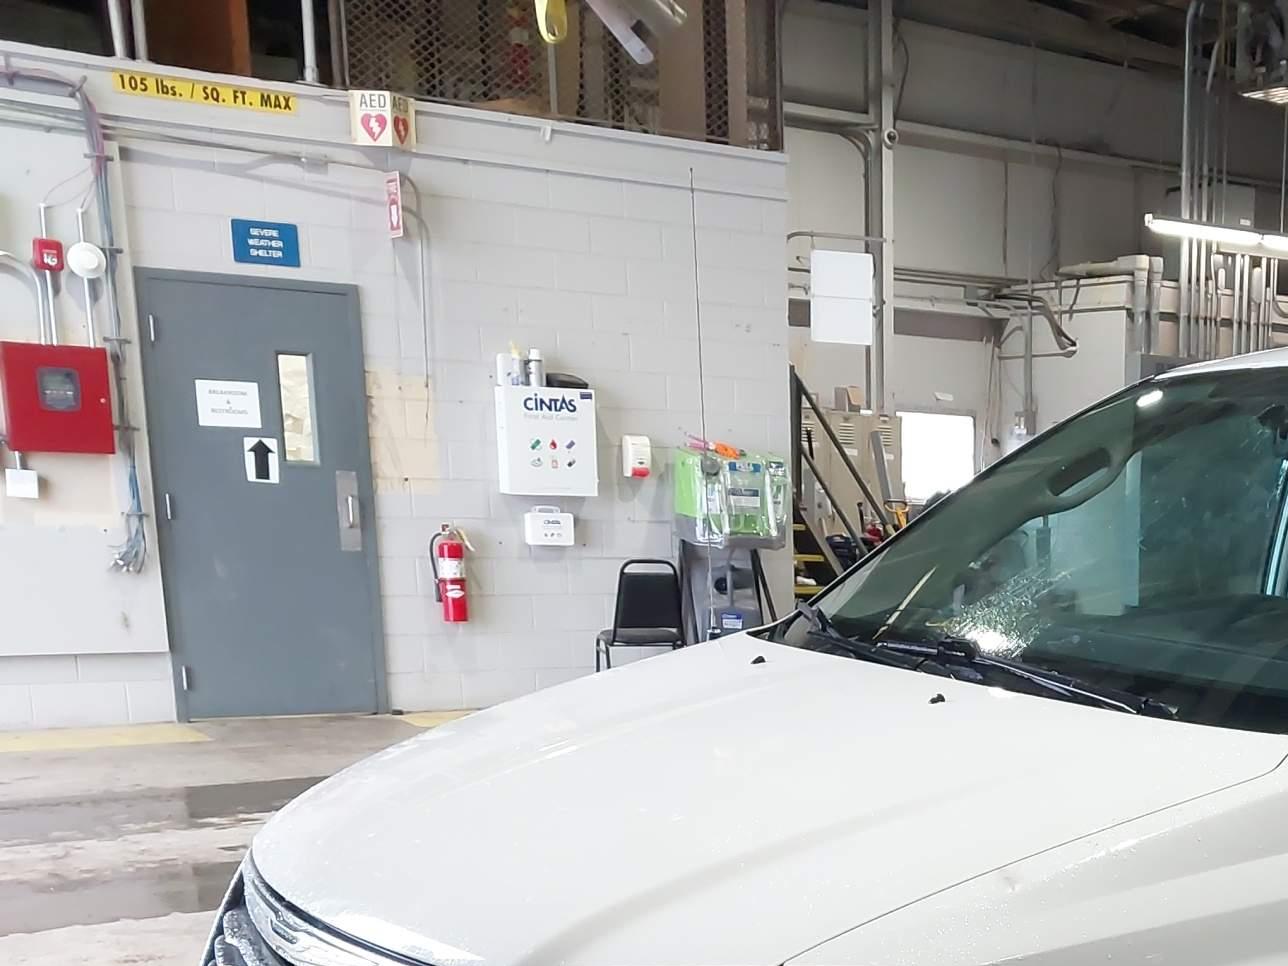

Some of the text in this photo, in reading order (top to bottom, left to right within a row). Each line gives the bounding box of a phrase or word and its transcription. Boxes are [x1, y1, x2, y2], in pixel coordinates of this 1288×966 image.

[119, 74, 292, 111] 105 lbs. / SQ. FT. MAX
[360, 94, 387, 109] AED
[392, 95, 409, 113] AED
[249, 227, 280, 238] SEVERE
[247, 238, 284, 248] WEATHER
[249, 248, 283, 258] SHELTER
